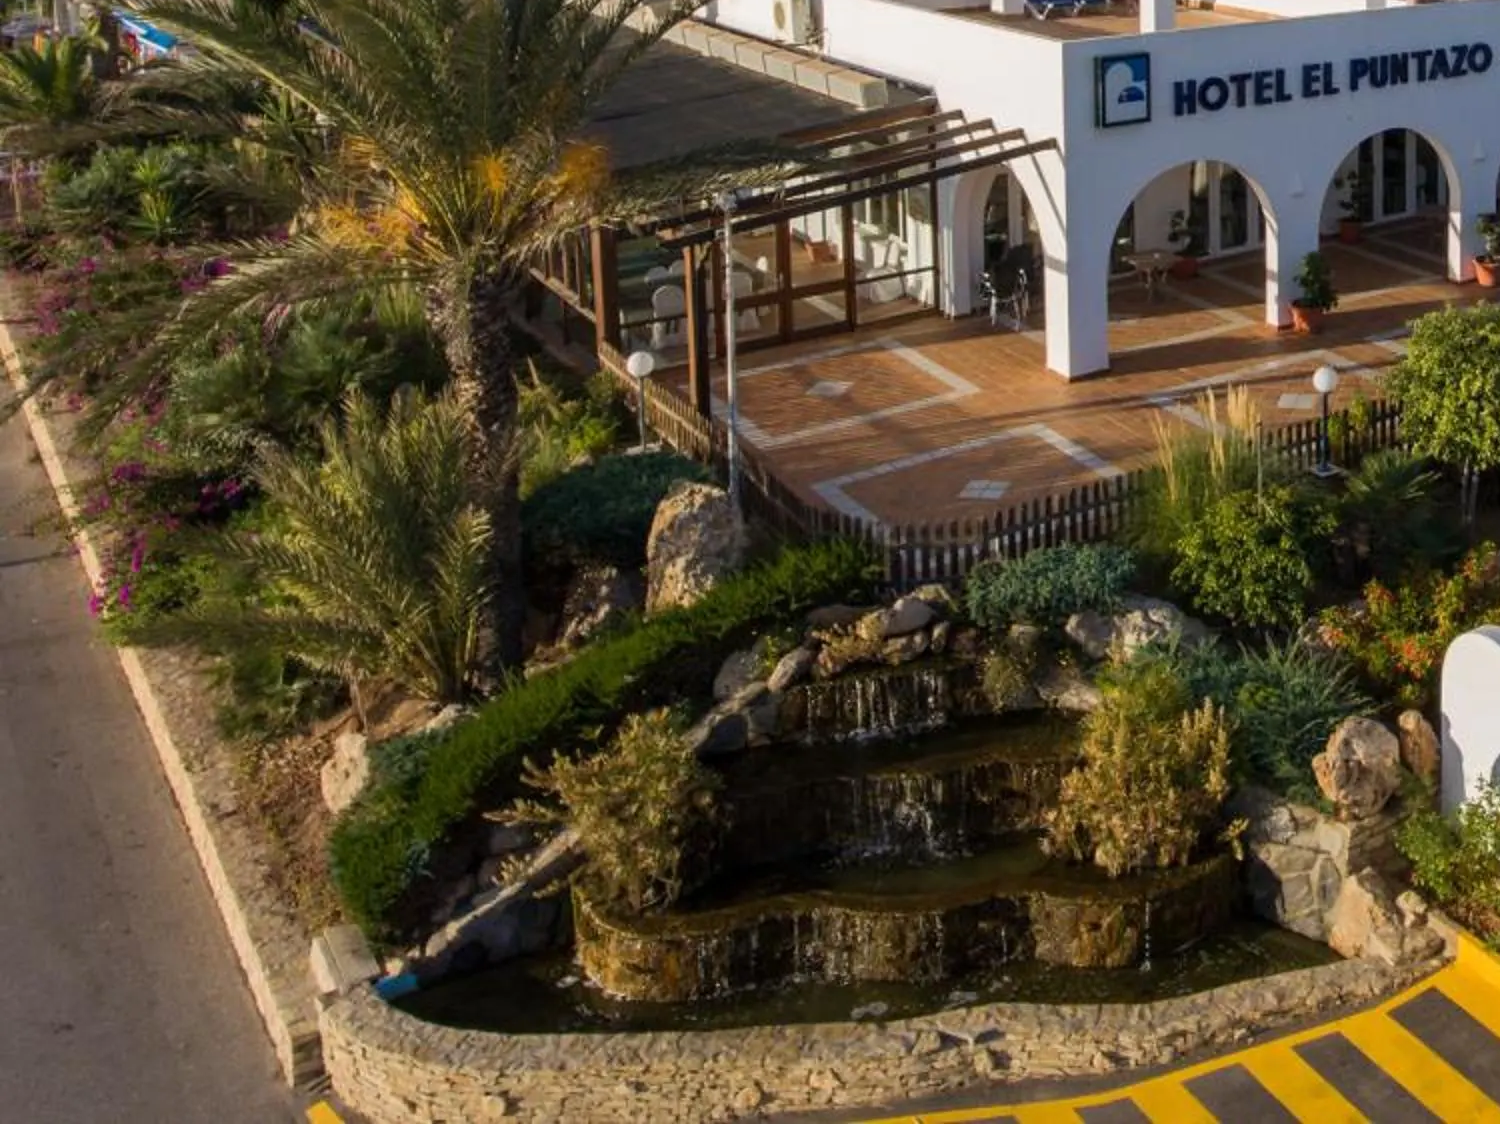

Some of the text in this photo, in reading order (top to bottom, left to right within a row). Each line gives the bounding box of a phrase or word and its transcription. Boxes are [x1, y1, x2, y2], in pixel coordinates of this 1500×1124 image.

[1173, 42, 1493, 117] HOTEL EL PUNTAZO
